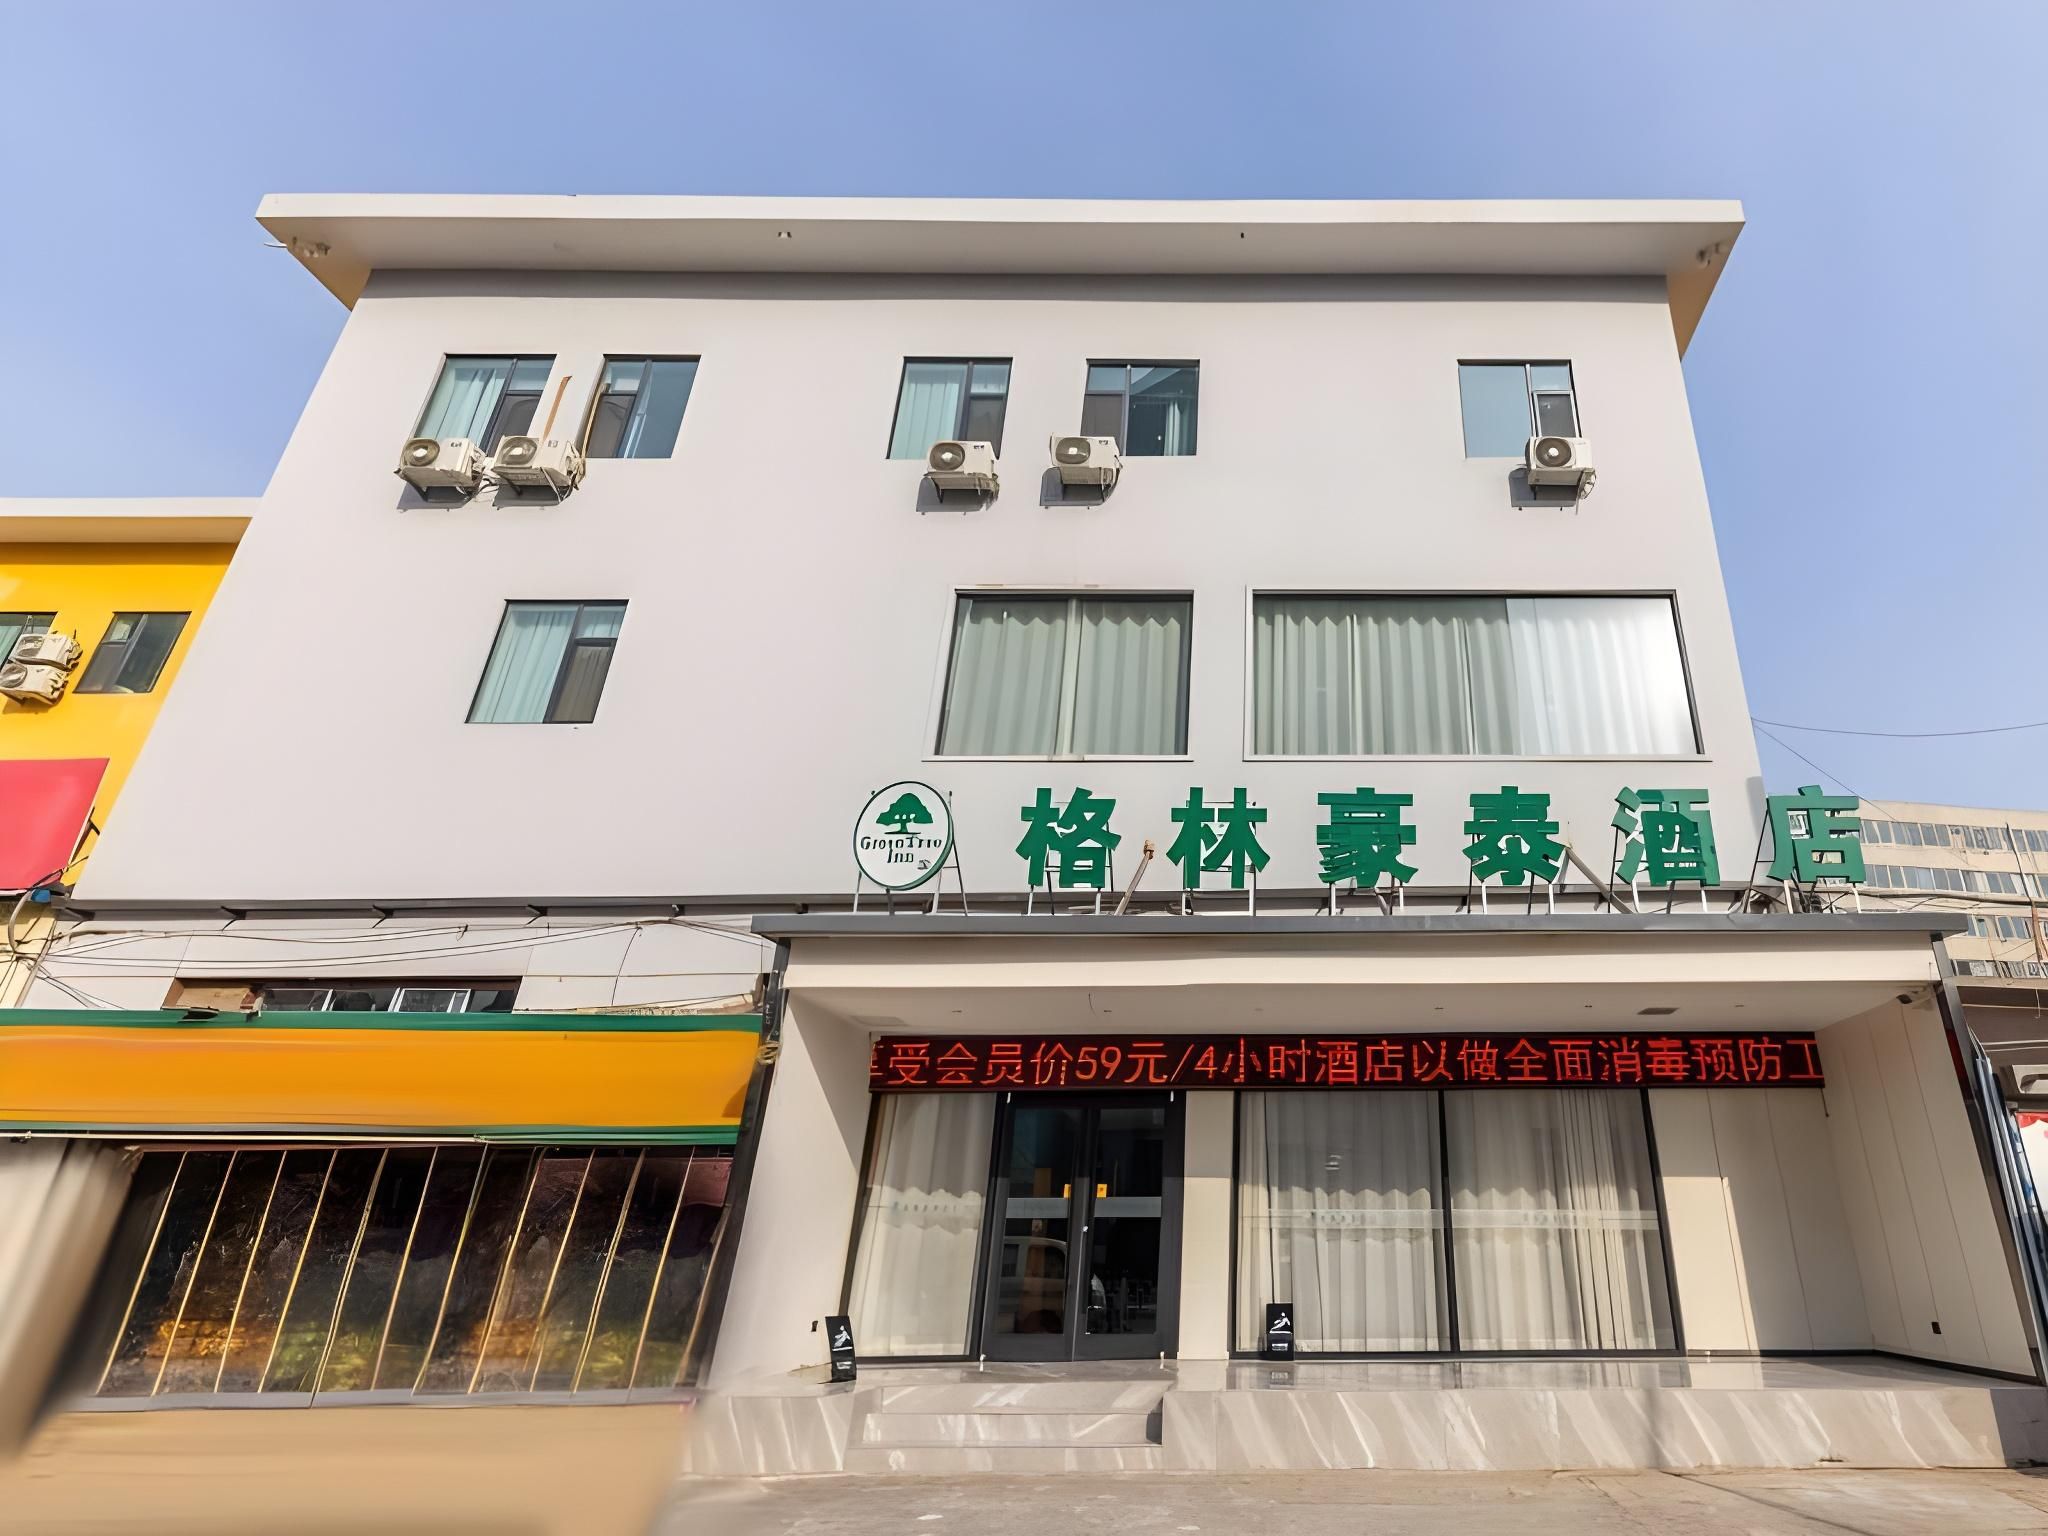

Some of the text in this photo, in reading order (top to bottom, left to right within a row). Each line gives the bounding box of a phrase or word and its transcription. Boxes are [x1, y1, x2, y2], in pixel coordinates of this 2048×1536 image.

[1016, 785, 1865, 889] 格林豪泰酒店
